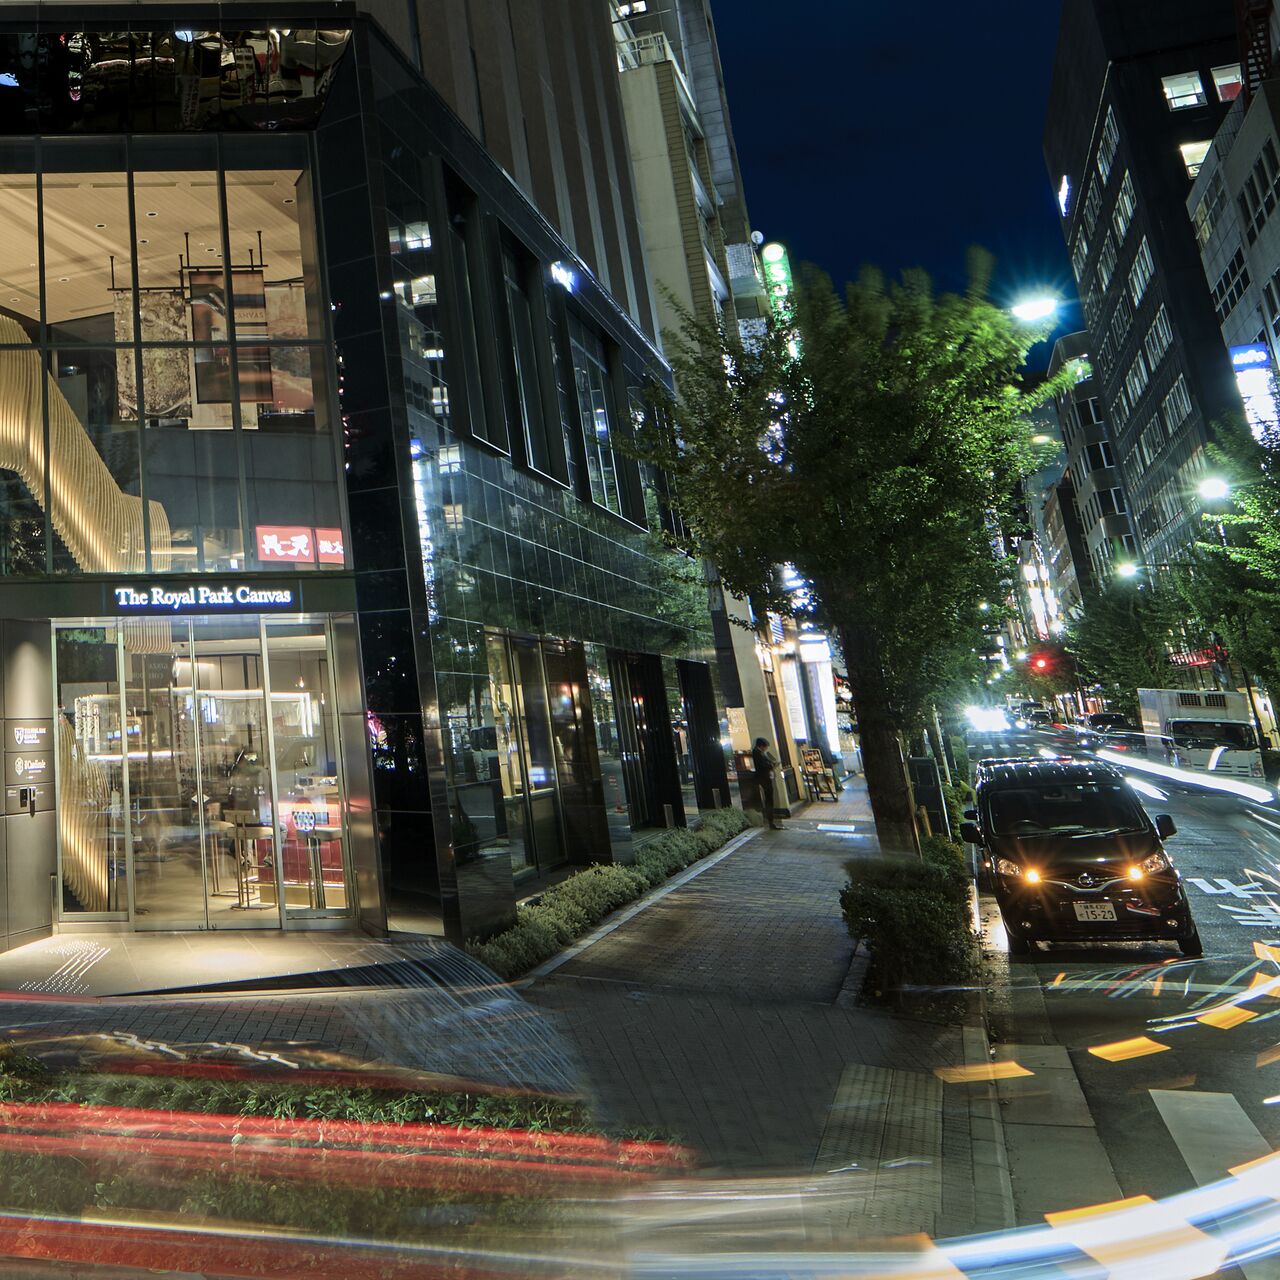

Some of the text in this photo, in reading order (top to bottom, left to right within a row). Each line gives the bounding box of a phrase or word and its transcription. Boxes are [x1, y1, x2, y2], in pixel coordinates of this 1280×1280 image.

[115, 586, 291, 609] The Royal Park Canvas
